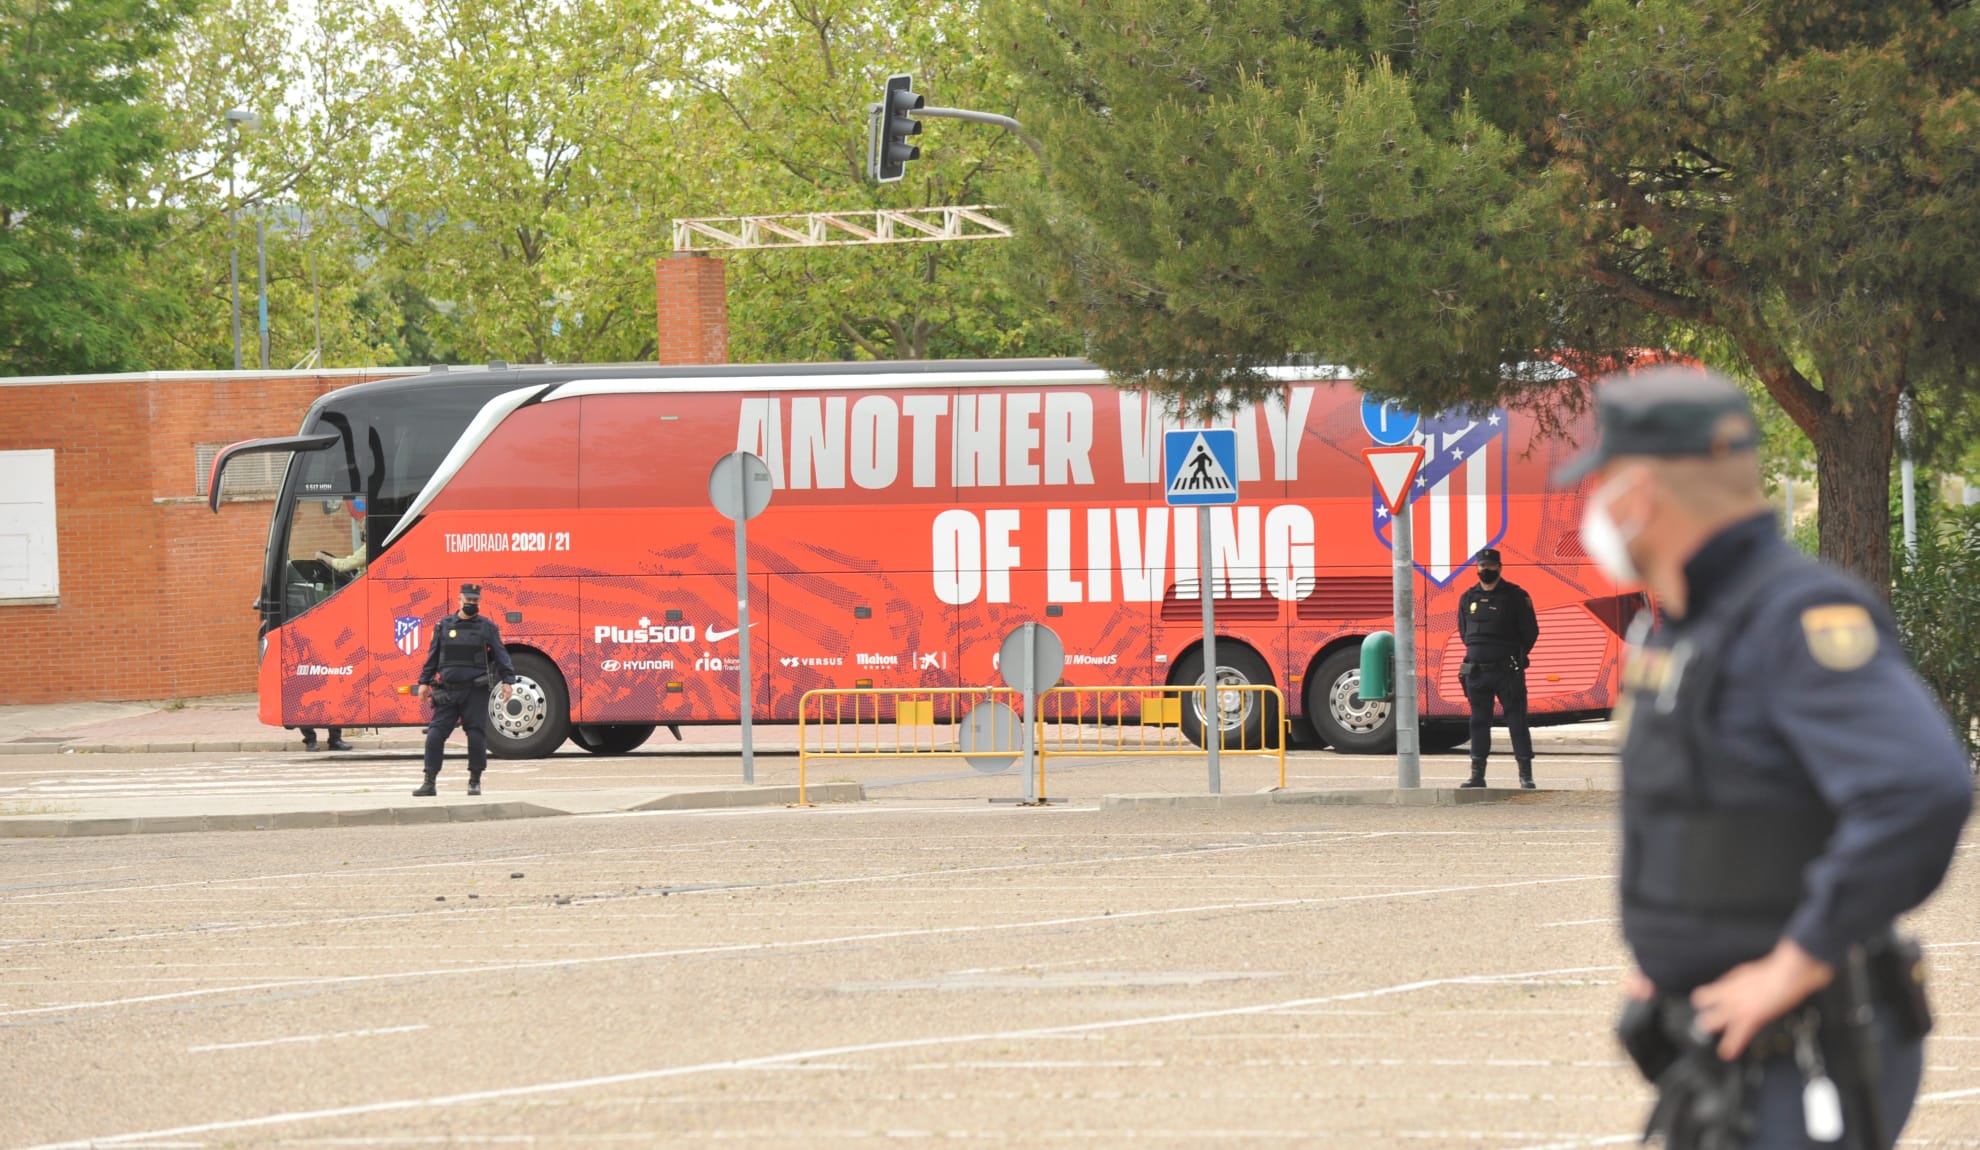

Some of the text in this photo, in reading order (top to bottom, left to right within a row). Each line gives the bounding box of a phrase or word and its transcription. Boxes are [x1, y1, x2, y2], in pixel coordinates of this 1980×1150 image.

[736, 391, 1096, 491] ANOTHER
[444, 532, 570, 553] TEMPORADA 2020 / 21
[932, 504, 1316, 605] OF LIVING
[594, 618, 696, 644] Plus500
[623, 659, 674, 670] HYUNDAI
[695, 651, 722, 671] ria
[801, 657, 844, 667] VERSUS
[855, 652, 899, 665] Mahou
